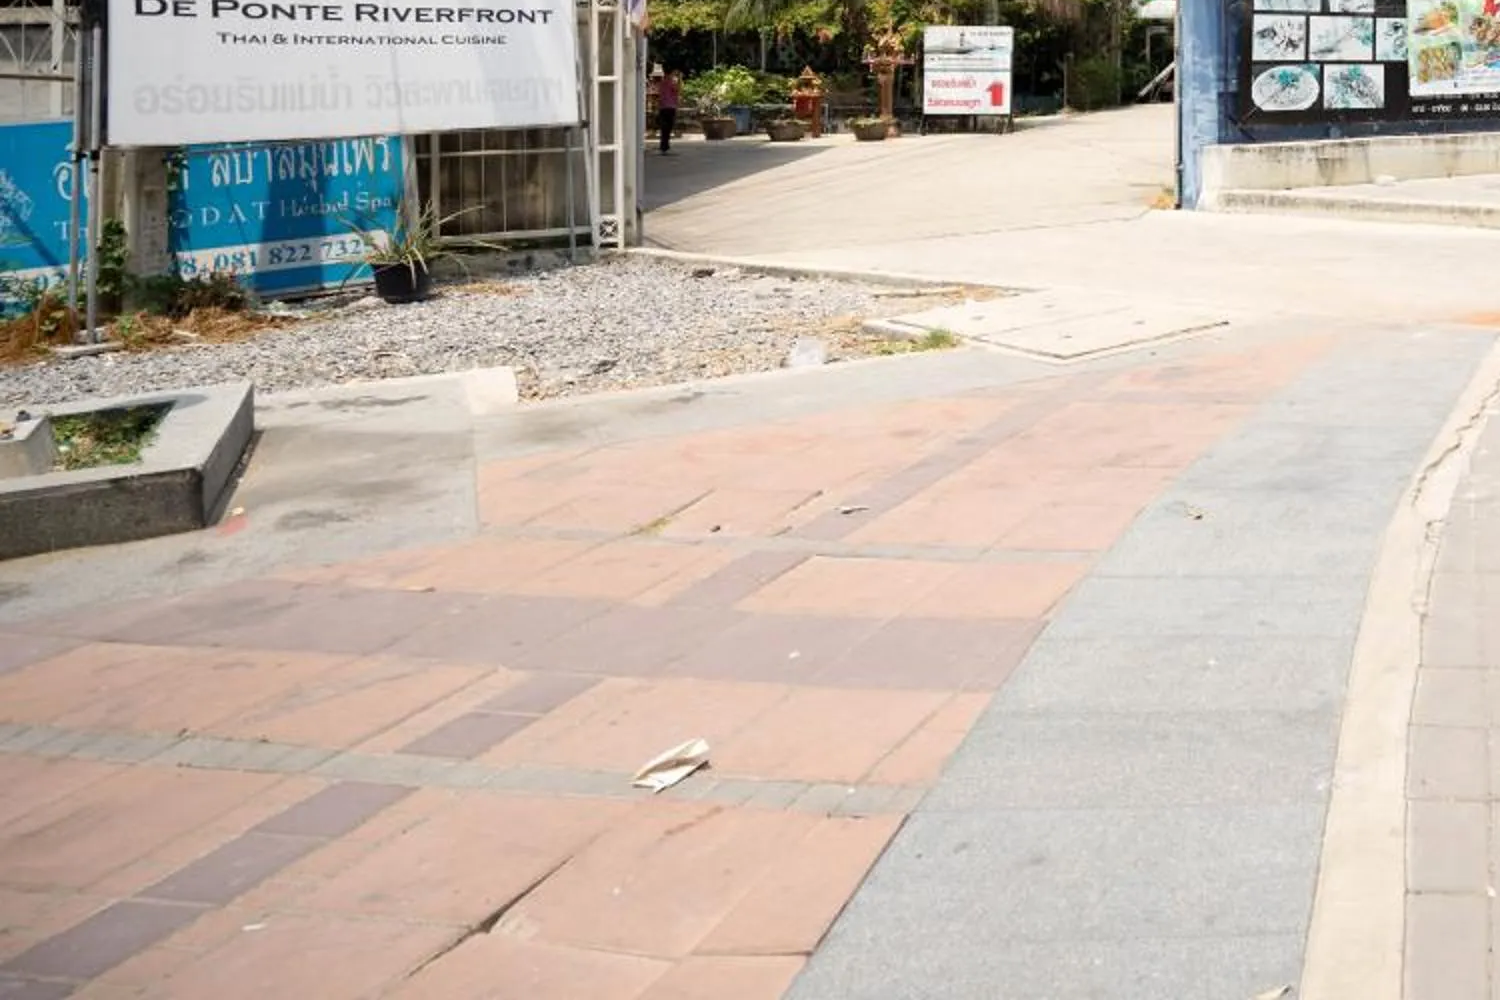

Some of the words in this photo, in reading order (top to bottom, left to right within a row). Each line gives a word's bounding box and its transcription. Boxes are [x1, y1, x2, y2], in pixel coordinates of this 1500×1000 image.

[355, 3, 554, 25] RIVERFRONT
[272, 33, 287, 45] &
[268, 243, 312, 265] 822
